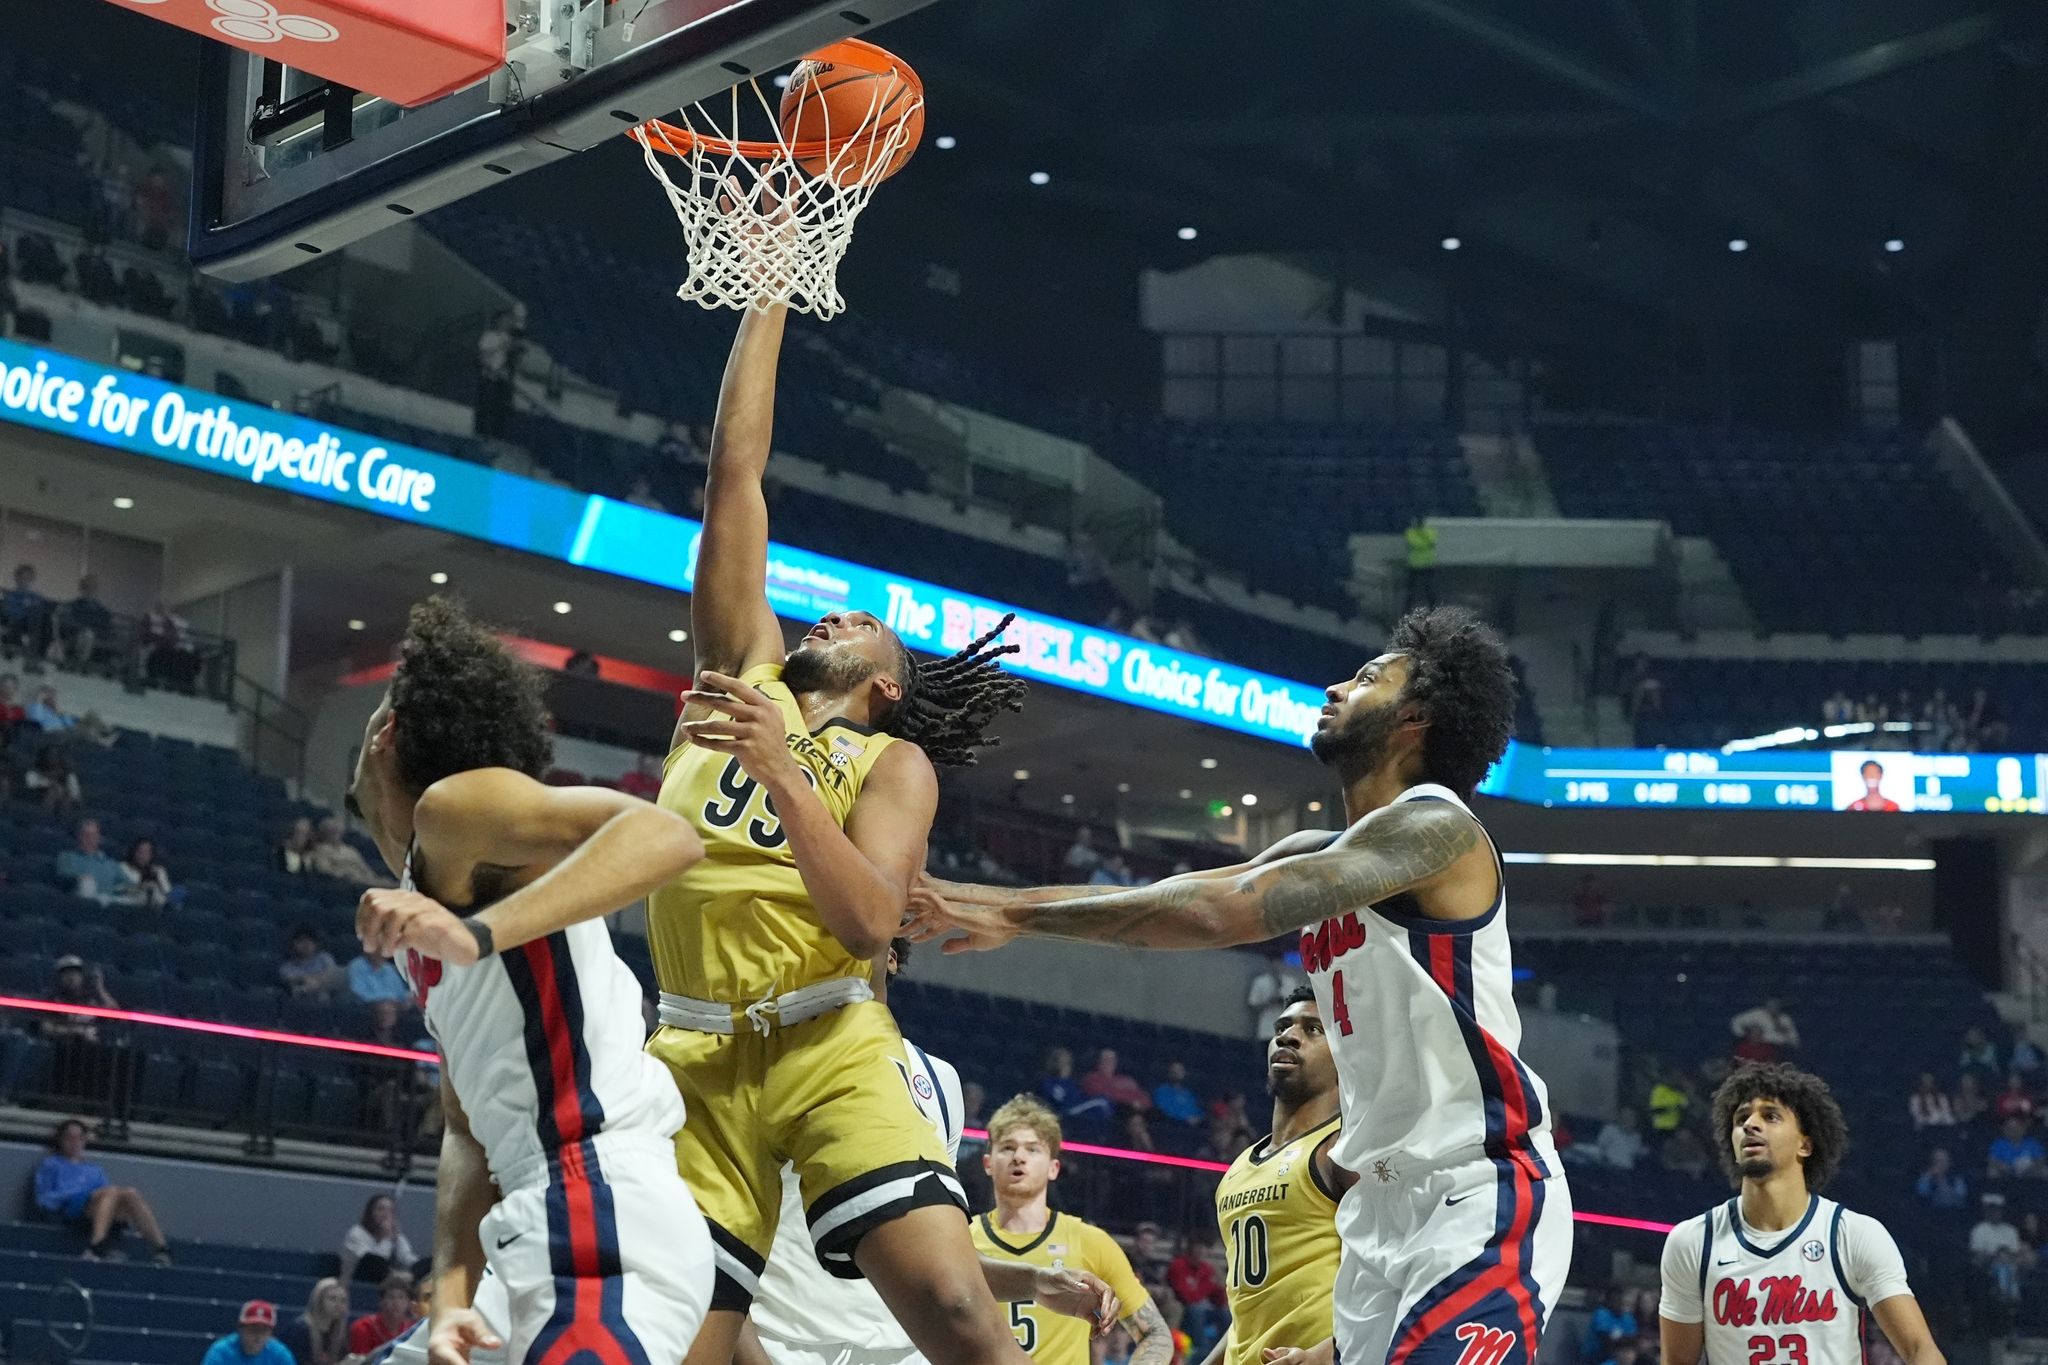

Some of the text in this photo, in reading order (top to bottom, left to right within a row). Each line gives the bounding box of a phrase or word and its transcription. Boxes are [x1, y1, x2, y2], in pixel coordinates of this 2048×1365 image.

[0, 360, 436, 512] oice for Orthopedic Care
[886, 582, 935, 639] The
[1122, 648, 1203, 708] Choice
[1203, 668, 1240, 717] for
[1332, 969, 1353, 1037] 4
[1218, 1183, 1289, 1213] VANDERBILT
[1230, 1213, 1269, 1289] 10
[1008, 1299, 1037, 1354] 5
[1713, 1274, 1838, 1328] Ole Miss
[1748, 1333, 1809, 1365] 23
